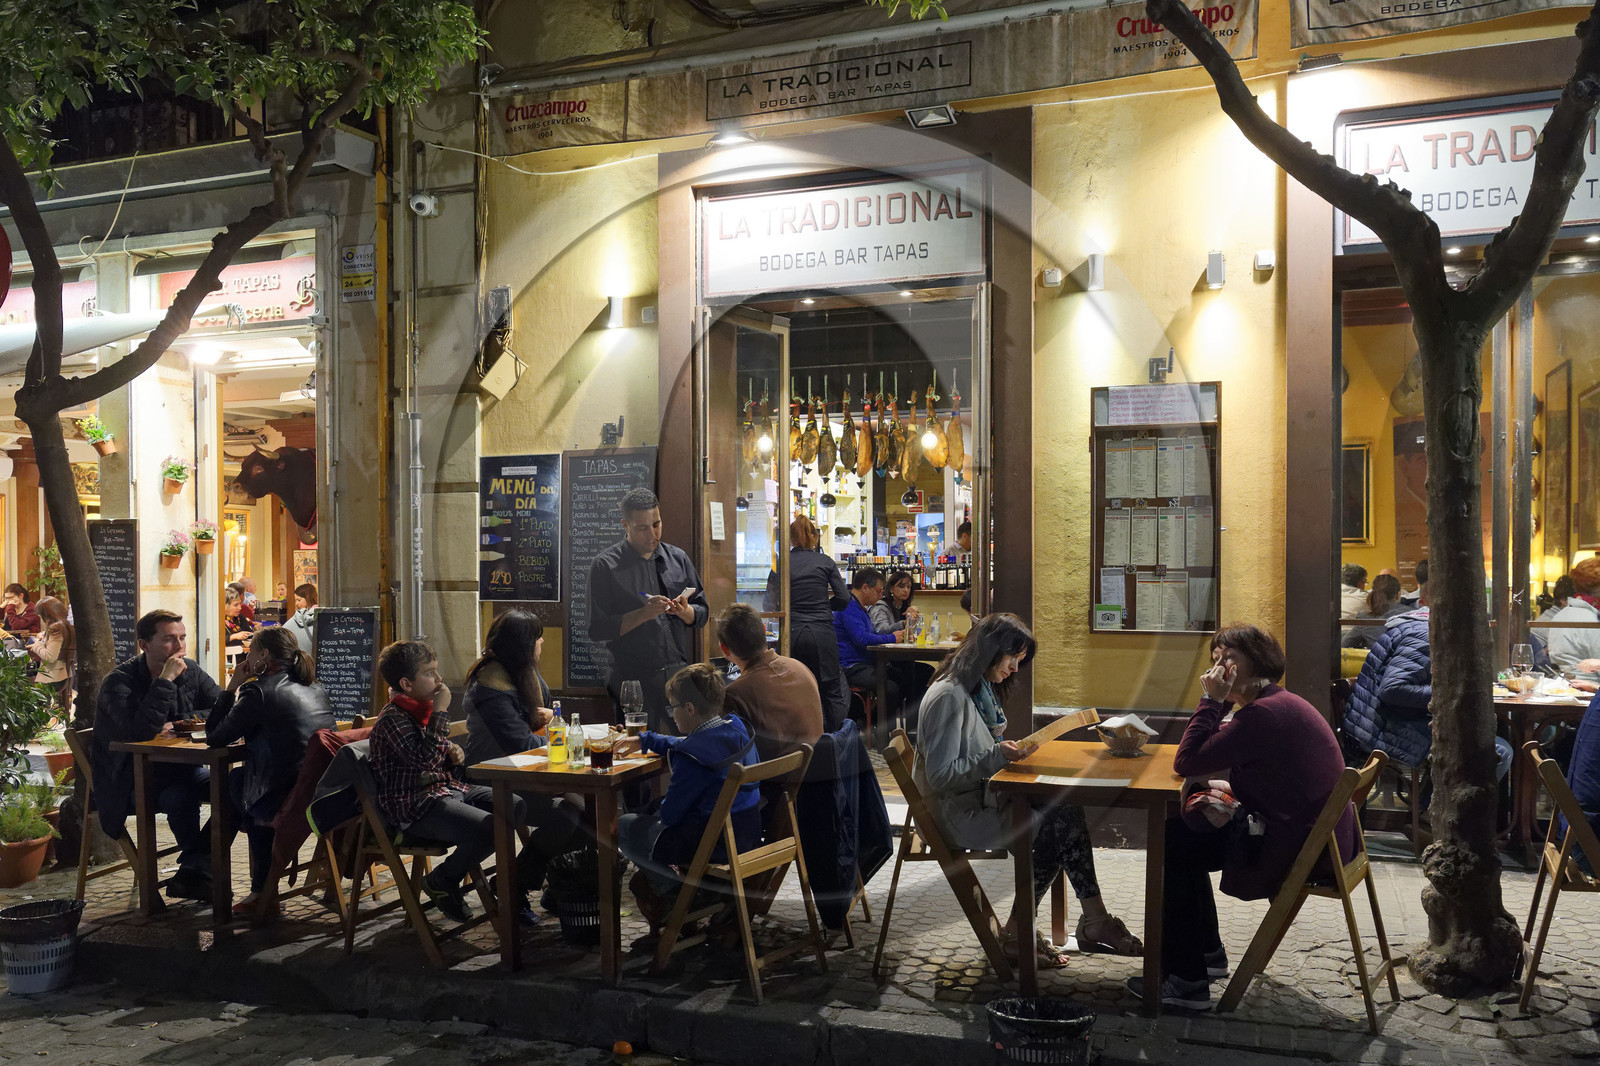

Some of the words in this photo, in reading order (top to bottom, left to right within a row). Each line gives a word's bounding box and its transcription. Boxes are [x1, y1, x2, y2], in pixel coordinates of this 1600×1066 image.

[1381, 0, 1462, 14] BODEGA
[1117, 4, 1234, 38] Cruzmpo
[1113, 39, 1168, 53] MAESTROS
[1163, 48, 1187, 59] 1904
[723, 83, 752, 99] LA
[763, 54, 952, 92] TRADICIONAL
[760, 94, 817, 109] BODEGA
[829, 88, 856, 99] BAR
[866, 80, 912, 94] TAPAS
[505, 100, 587, 122] Cruzcampo
[505, 122, 540, 134] MAESTROS
[542, 116, 591, 127] CERVECEROS
[1365, 143, 1409, 175] LA
[1422, 187, 1518, 212] BODEGA
[719, 211, 750, 240] LA
[761, 187, 973, 235] TRADICIONAL
[760, 251, 827, 272] BODEGA
[834, 247, 867, 265] BAR
[874, 242, 929, 263] TAPAS
[233, 273, 281, 294] TAPAS
[582, 459, 617, 474] TAPAS
[489, 477, 535, 495] MENÚ
[540, 485, 556, 494] DEL
[515, 497, 537, 510] DÍA
[530, 517, 554, 530] PLATO
[529, 536, 552, 548] PLATO
[519, 555, 550, 566] BEBIDA
[519, 571, 546, 583] POSTRE
